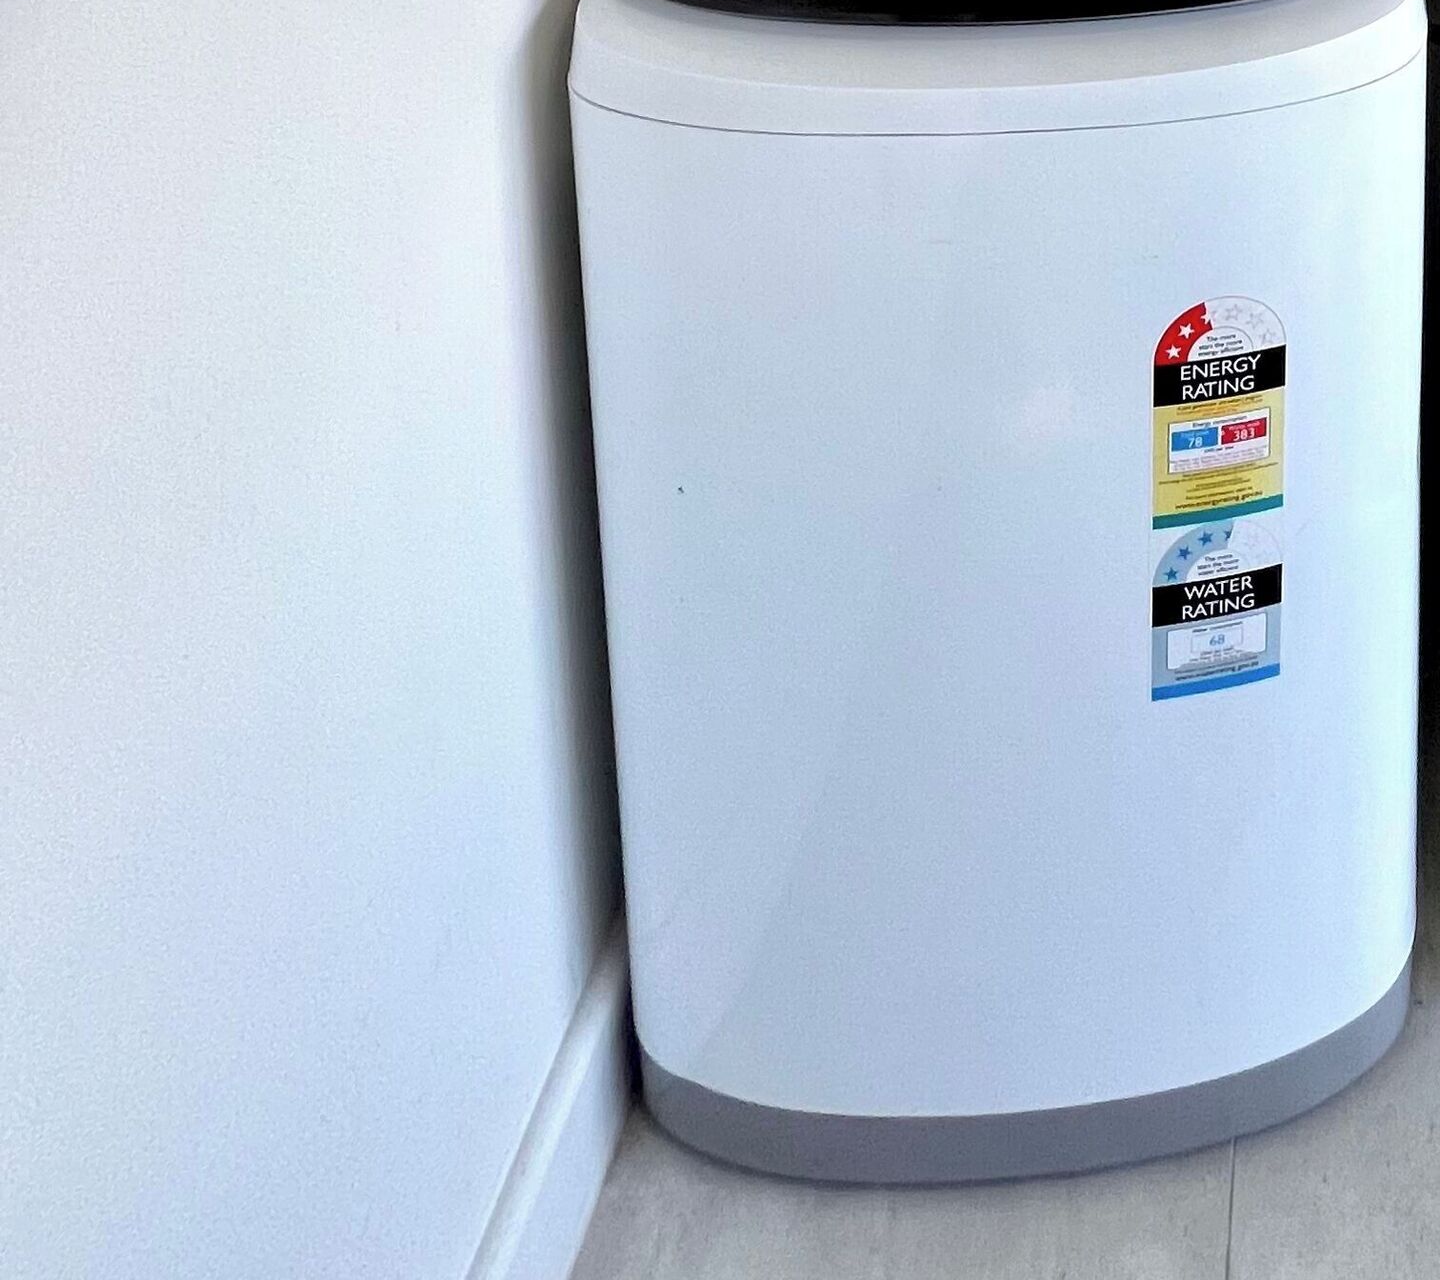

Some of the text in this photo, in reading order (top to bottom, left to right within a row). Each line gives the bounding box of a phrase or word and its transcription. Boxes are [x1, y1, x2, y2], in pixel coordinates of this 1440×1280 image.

[1180, 354, 1262, 381] ENERGY
[1182, 375, 1255, 400] RATING
[1188, 436, 1203, 449] 78
[1233, 428, 1256, 441] 383
[1184, 576, 1254, 600] WATER
[1182, 593, 1255, 620] RATING
[1209, 633, 1226, 646] 68
